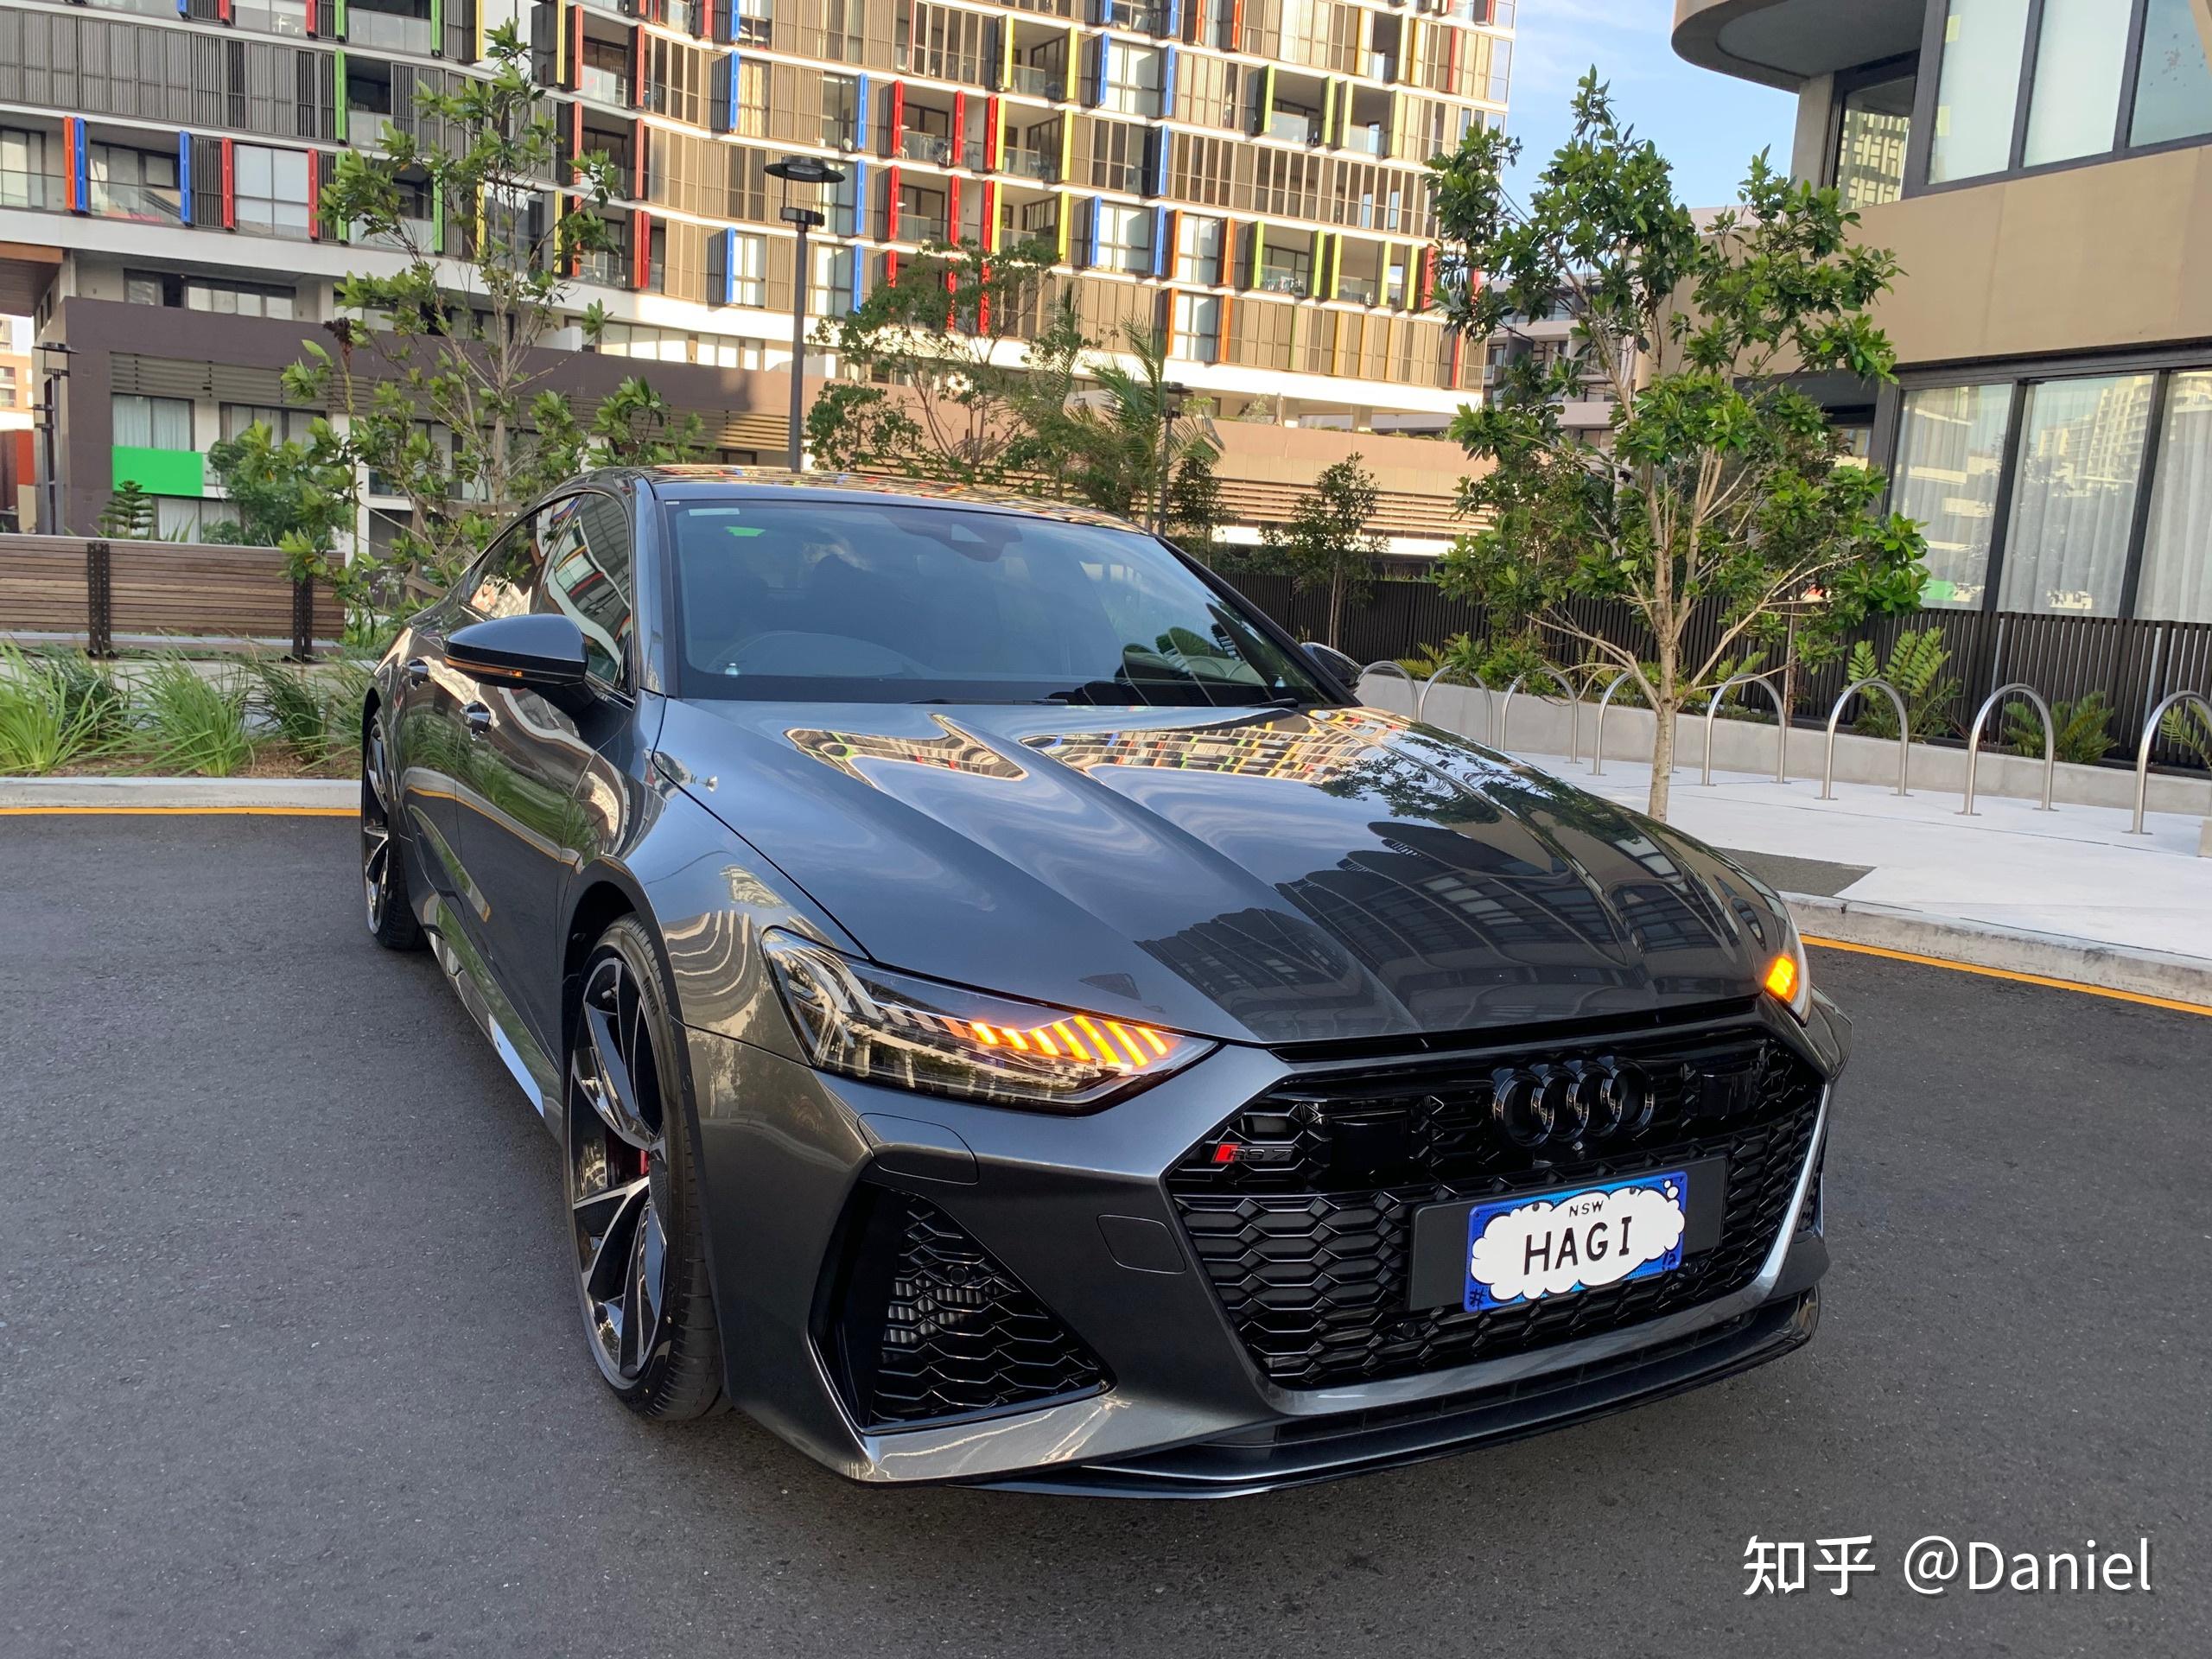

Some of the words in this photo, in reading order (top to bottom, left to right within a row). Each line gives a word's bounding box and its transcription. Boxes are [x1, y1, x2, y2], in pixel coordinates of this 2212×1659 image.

[1230, 1148, 1265, 1160] RS
[1272, 1148, 1293, 1160] 7
[1568, 1200, 1605, 1217] NSW
[1523, 1216, 1632, 1275] HAGI
